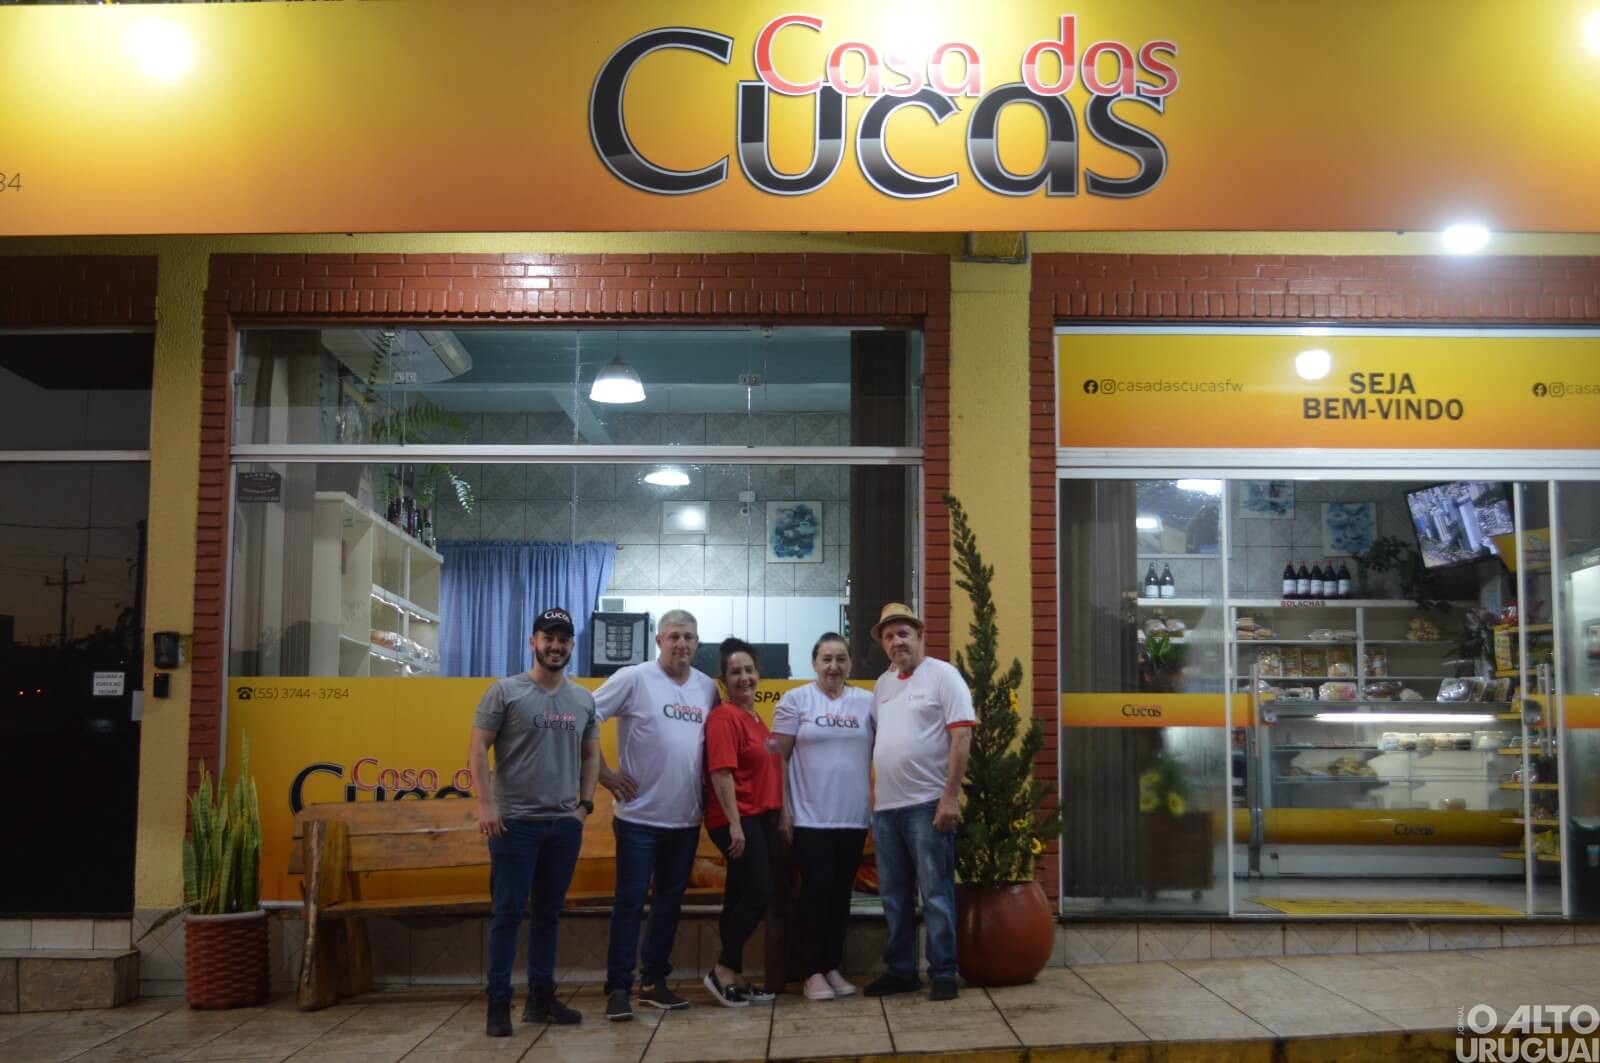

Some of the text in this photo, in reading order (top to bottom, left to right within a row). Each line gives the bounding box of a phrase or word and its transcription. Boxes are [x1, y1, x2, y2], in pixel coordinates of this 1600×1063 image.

[754, 13, 1179, 98] Casa das
[588, 26, 1168, 199] Cucas
[1117, 378, 1244, 393] casadascucasfw
[1349, 372, 1416, 395] SEJA
[1302, 398, 1464, 421] BEM-VINDO
[253, 687, 349, 701] (55) 3744-3784
[352, 757, 439, 792] Casa
